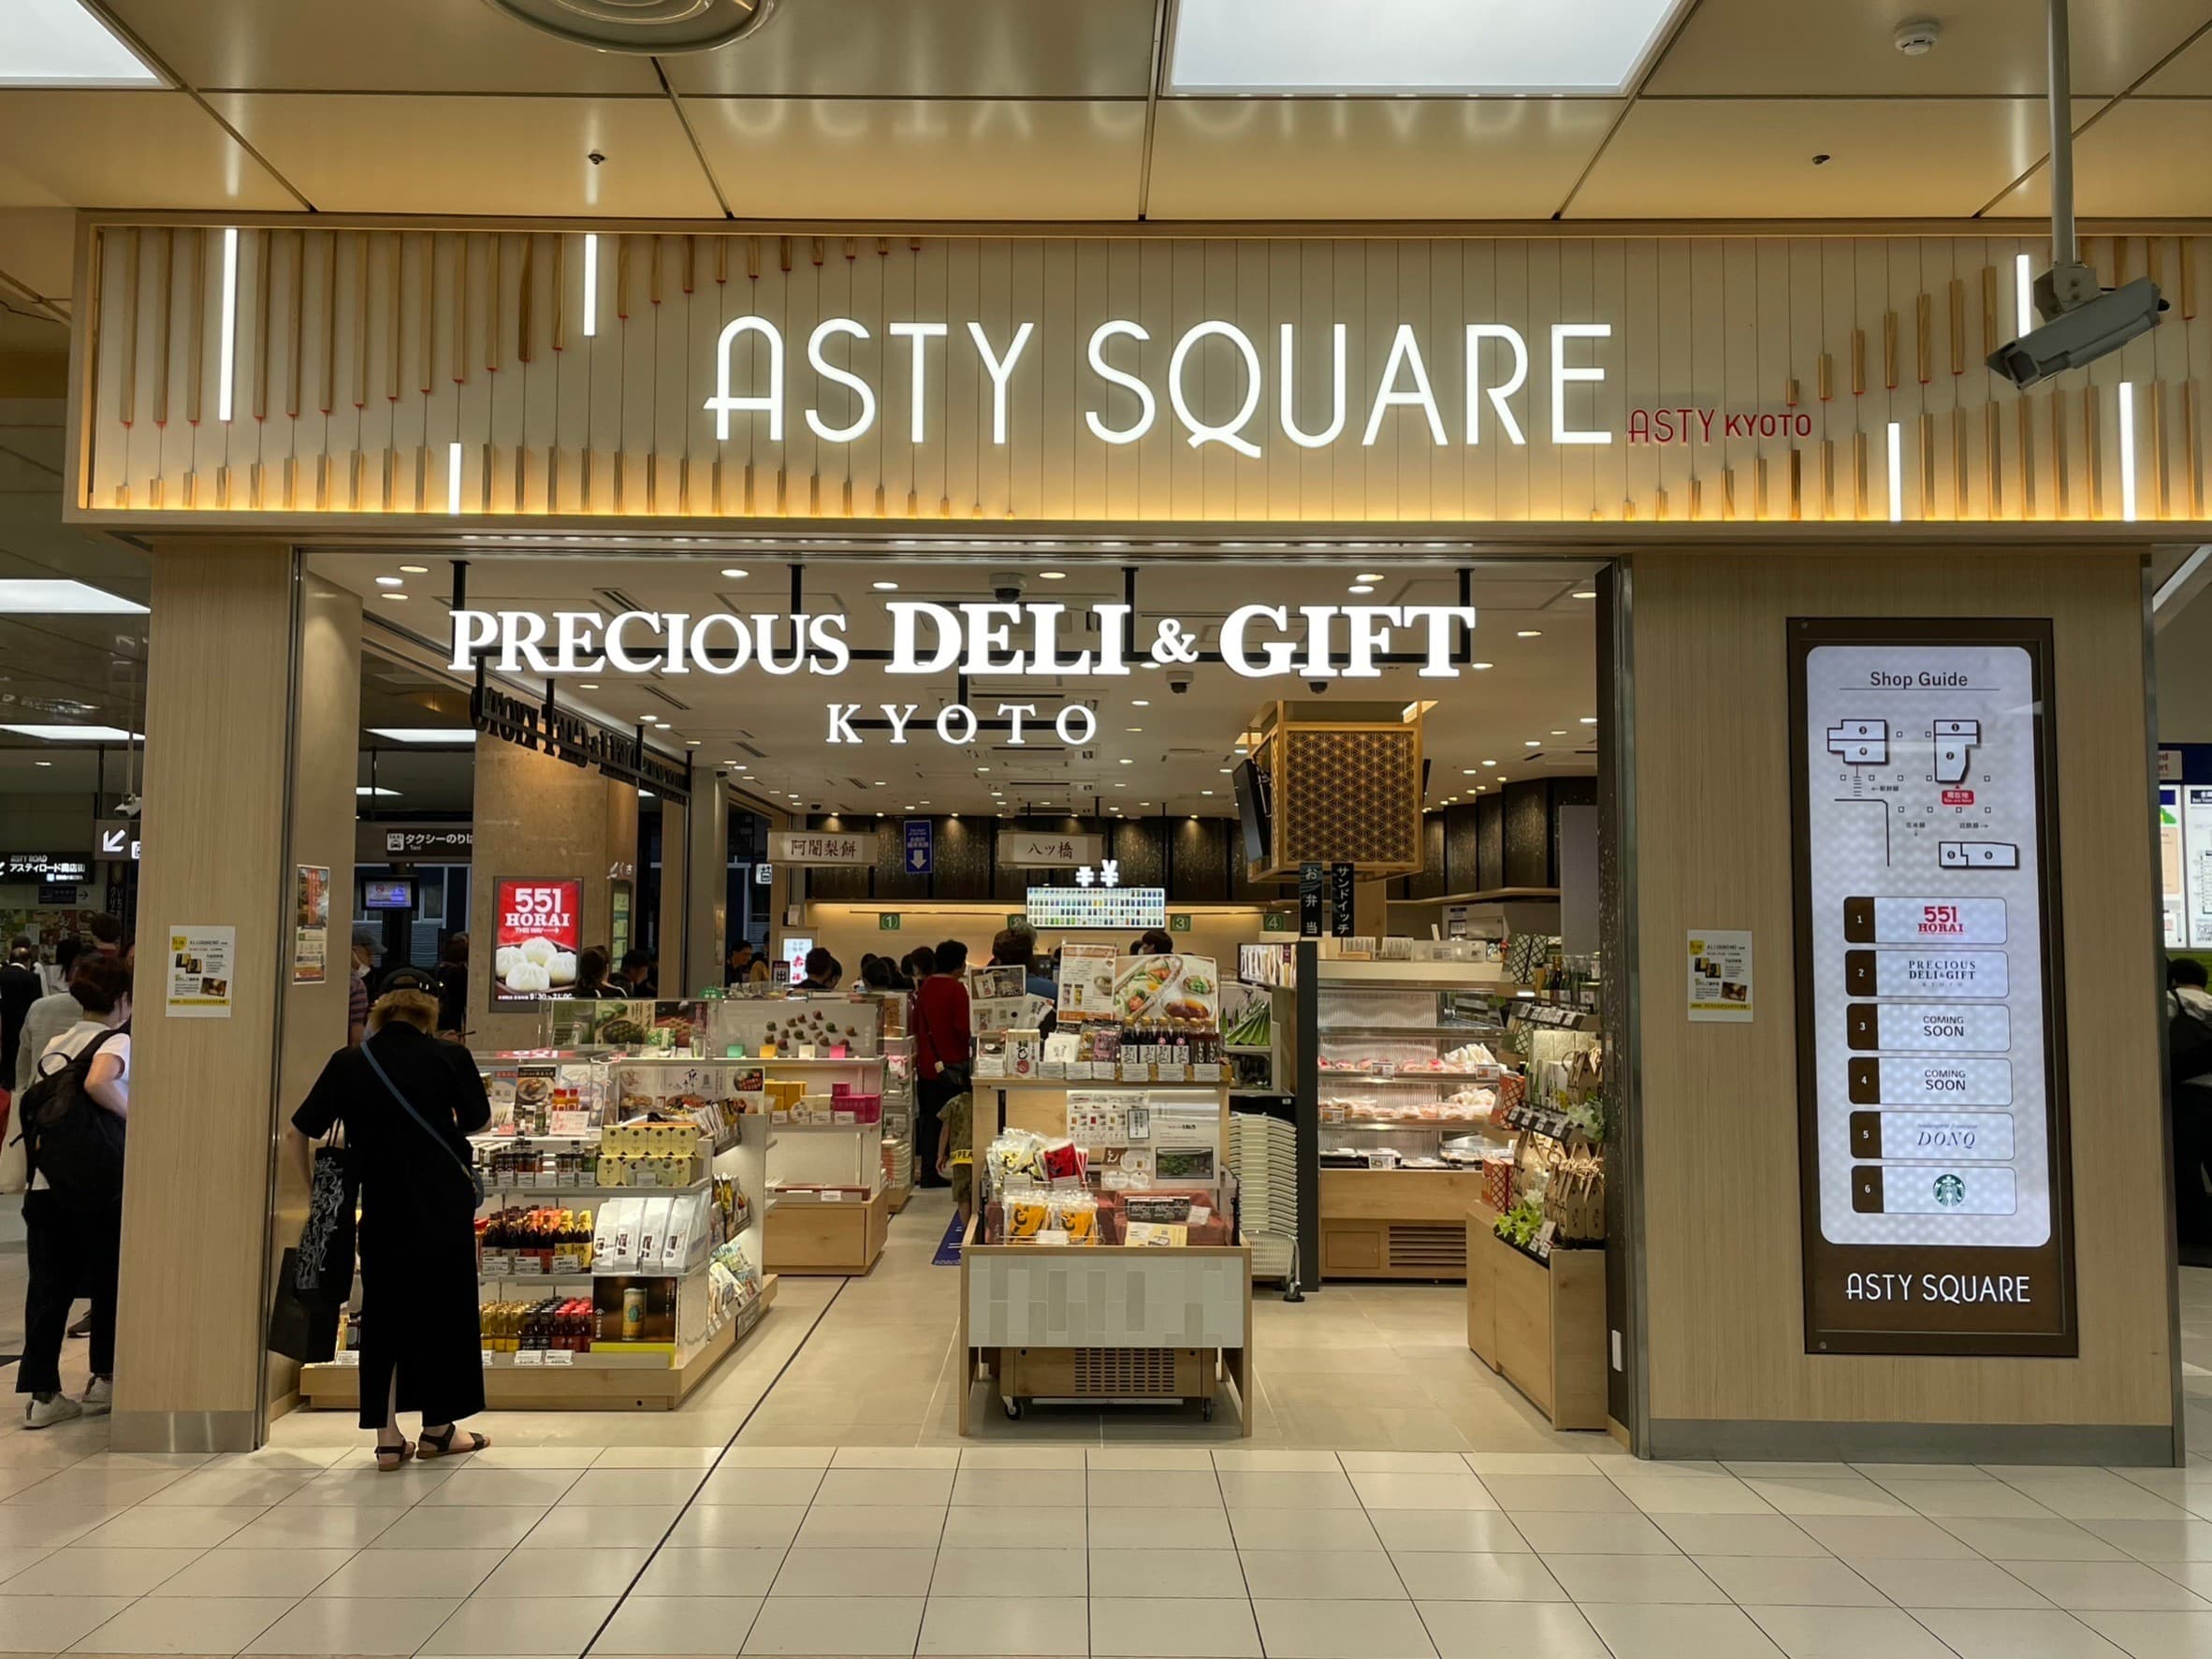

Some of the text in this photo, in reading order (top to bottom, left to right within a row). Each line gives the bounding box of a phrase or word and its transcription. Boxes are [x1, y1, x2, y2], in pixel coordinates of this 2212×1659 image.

[704, 315, 1612, 458] ASTY SQUARE
[1628, 409, 1812, 444] ASTY KYOTO
[447, 602, 1476, 678] PRECIOUS DELI & GIFT
[1870, 672, 1968, 689] Shop Guide
[826, 704, 1098, 745] KYOTO
[1028, 841, 1074, 859] 八ツ橋
[515, 888, 561, 913] 551
[1304, 866, 1318, 934] お弁当
[1336, 866, 1350, 934] サンドイッチ
[505, 913, 570, 926] HORAI
[1857, 915, 1862, 924] 1
[1924, 906, 1957, 923] 551
[1918, 924, 1963, 932] HORAI
[1909, 960, 1976, 969] PRECIOUS
[1923, 1016, 1964, 1025] COMING
[1924, 1026, 1964, 1037] SOON
[1861, 1076, 1867, 1084] 4
[1925, 1070, 1966, 1078] COMING
[1926, 1080, 1965, 1090] SOON
[1863, 1130, 1869, 1139] 5
[1918, 1131, 1975, 1149] DONQ
[1865, 1185, 1870, 1193] 6
[1846, 1273, 2030, 1304] ASTY SQUARE
